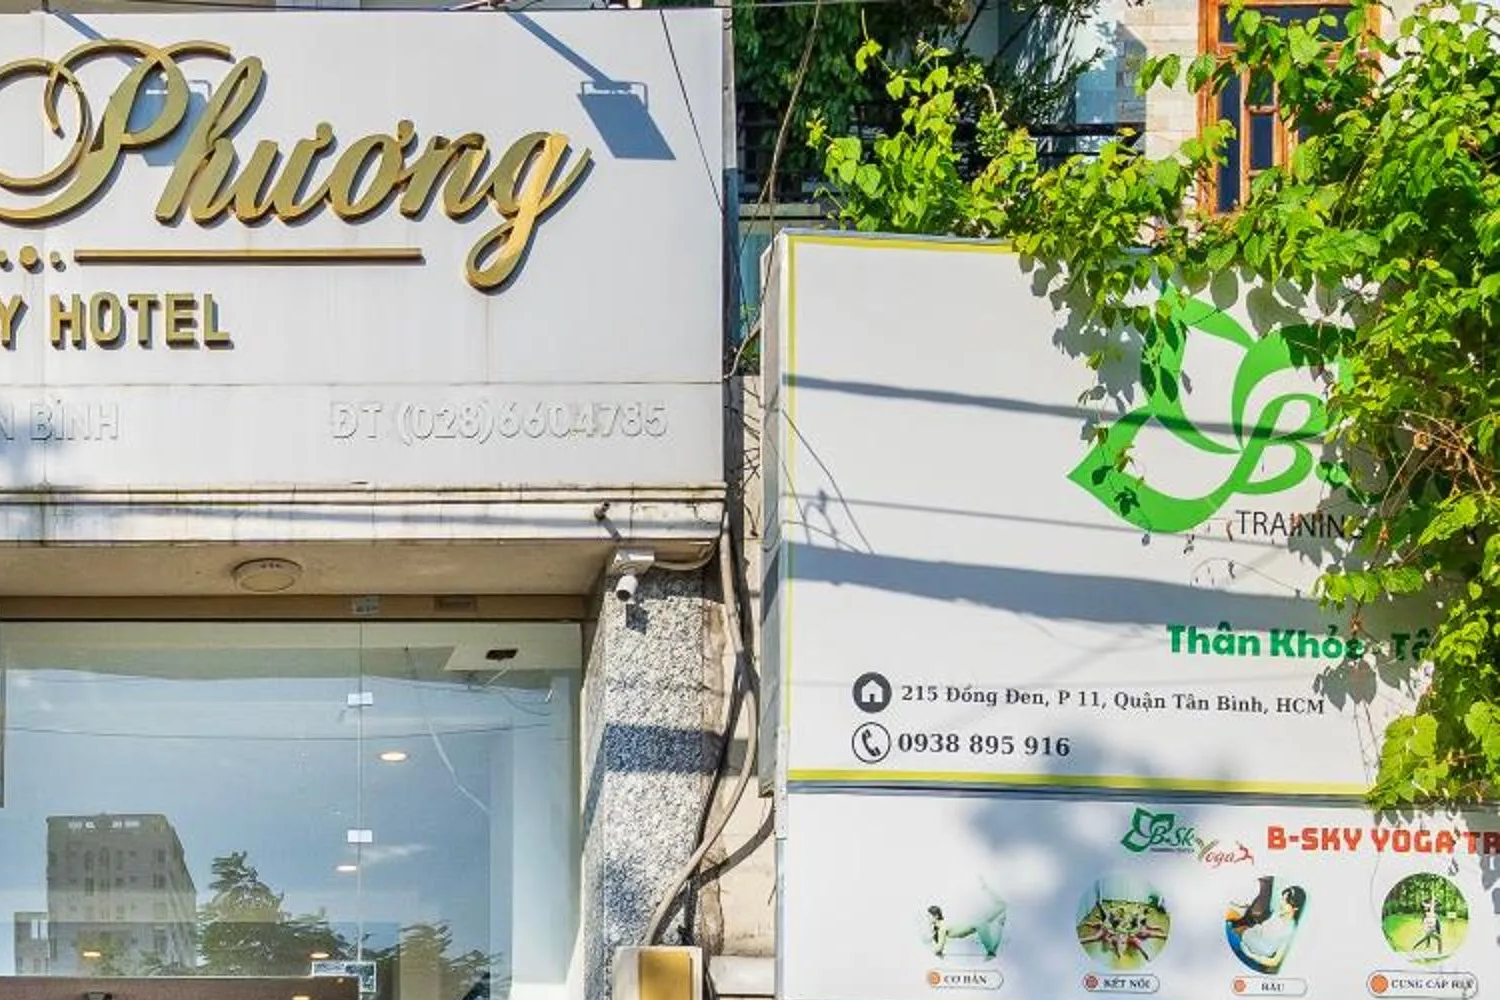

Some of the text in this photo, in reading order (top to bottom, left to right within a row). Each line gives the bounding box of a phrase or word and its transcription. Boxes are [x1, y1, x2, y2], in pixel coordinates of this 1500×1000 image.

[50, 293, 232, 349] HOTEL
[1166, 620, 1262, 657] Thân
[901, 685, 938, 702] 215
[1005, 688, 1049, 708] Đen,
[1058, 689, 1071, 705] P
[1079, 691, 1106, 709] 11,
[1114, 691, 1166, 713] Quận
[1172, 693, 1210, 711] Tân
[1276, 698, 1325, 714] HCM
[897, 733, 1071, 757] 0938 895 916
[1267, 826, 1363, 851] B-SKY
[1371, 828, 1455, 853] YOGA
